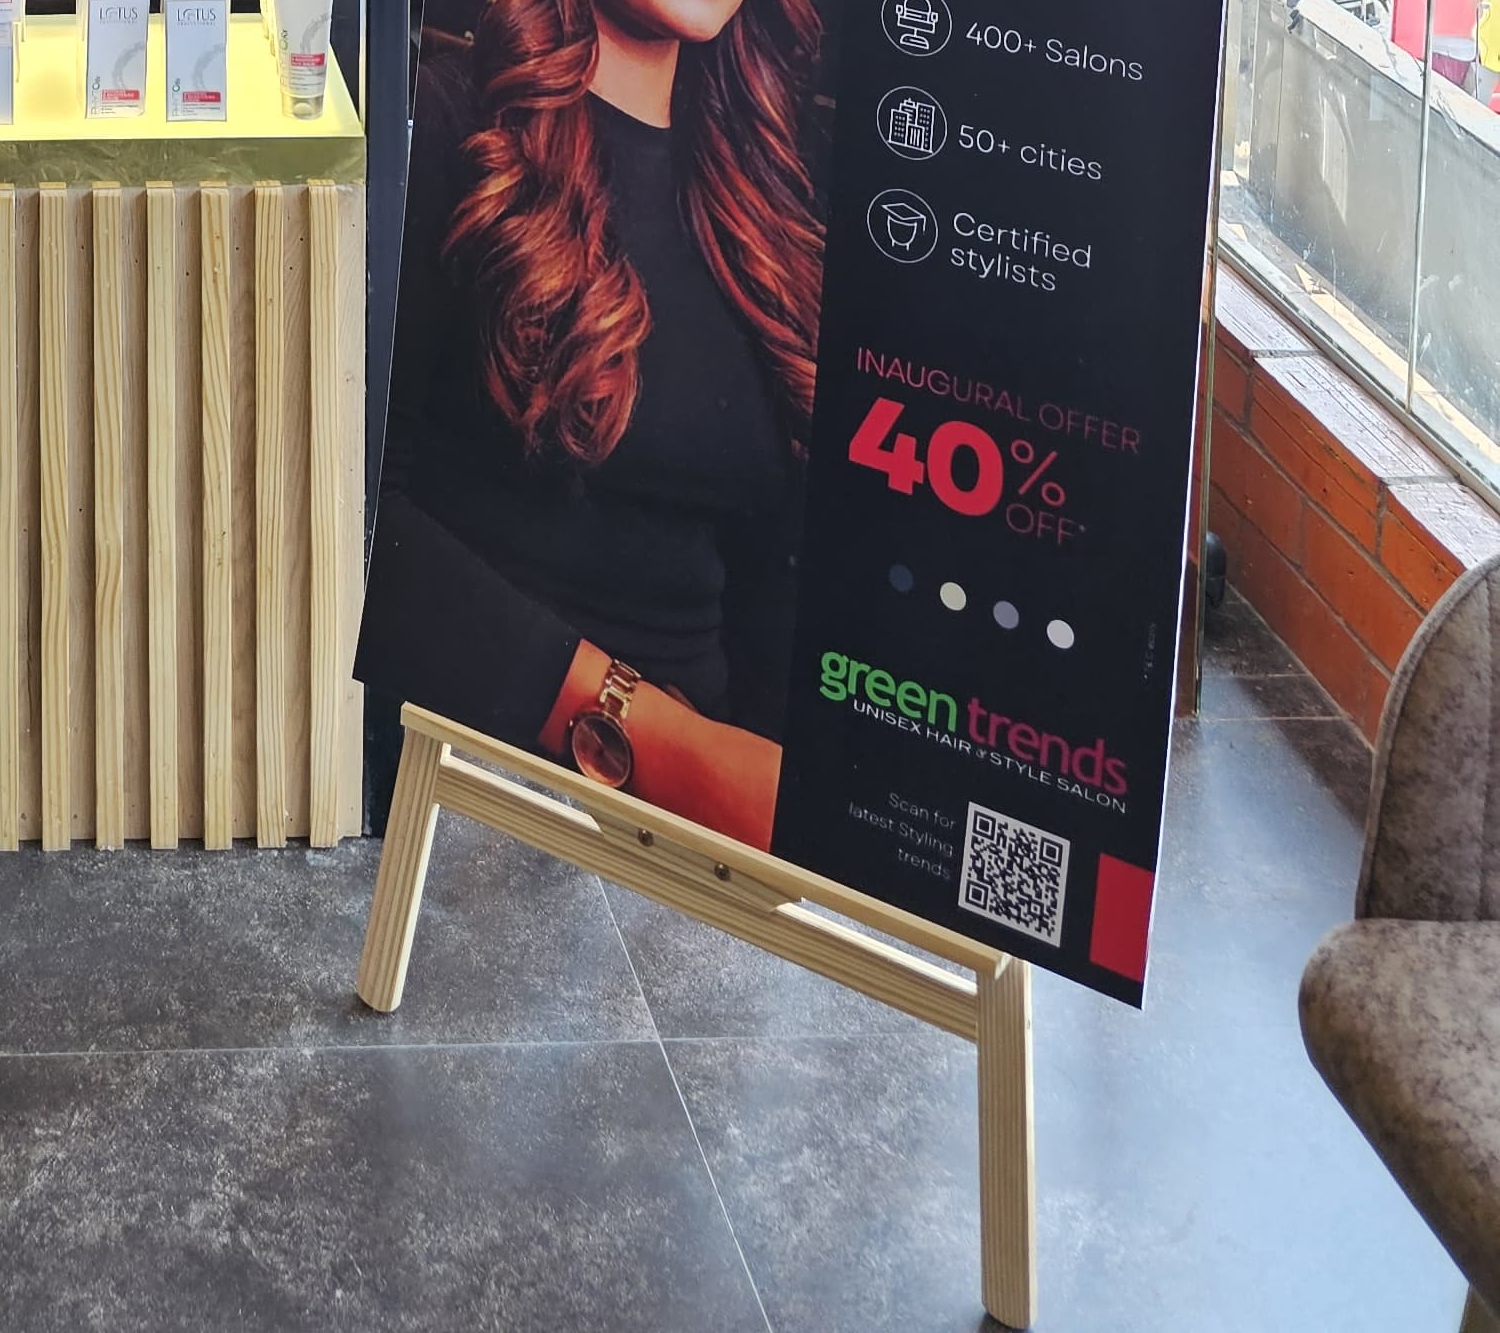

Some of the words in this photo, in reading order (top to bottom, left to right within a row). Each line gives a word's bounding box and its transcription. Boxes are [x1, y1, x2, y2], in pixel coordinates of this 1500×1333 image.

[100, 6, 138, 20] LOTUS
[177, 8, 217, 22] LOTUS
[966, 22, 1037, 54] 400+
[1045, 39, 1143, 81] Salons
[958, 125, 1010, 154] 50+
[1019, 144, 1102, 180] cities
[953, 213, 1092, 268] Certified
[950, 246, 1056, 291] stylists
[856, 346, 1032, 422] INAUGURAL
[1038, 403, 1141, 454] OFFER
[820, 651, 958, 733] green
[968, 697, 1128, 796] trends
[853, 699, 922, 736] UNISEX
[926, 728, 972, 755] HAIR
[989, 751, 1052, 786] STYLE
[1056, 777, 1127, 814] SALON
[848, 801, 894, 832] latest
[899, 822, 954, 858] Styling
[888, 792, 930, 820] Scan
[933, 810, 957, 830] for
[898, 848, 952, 880] trends
